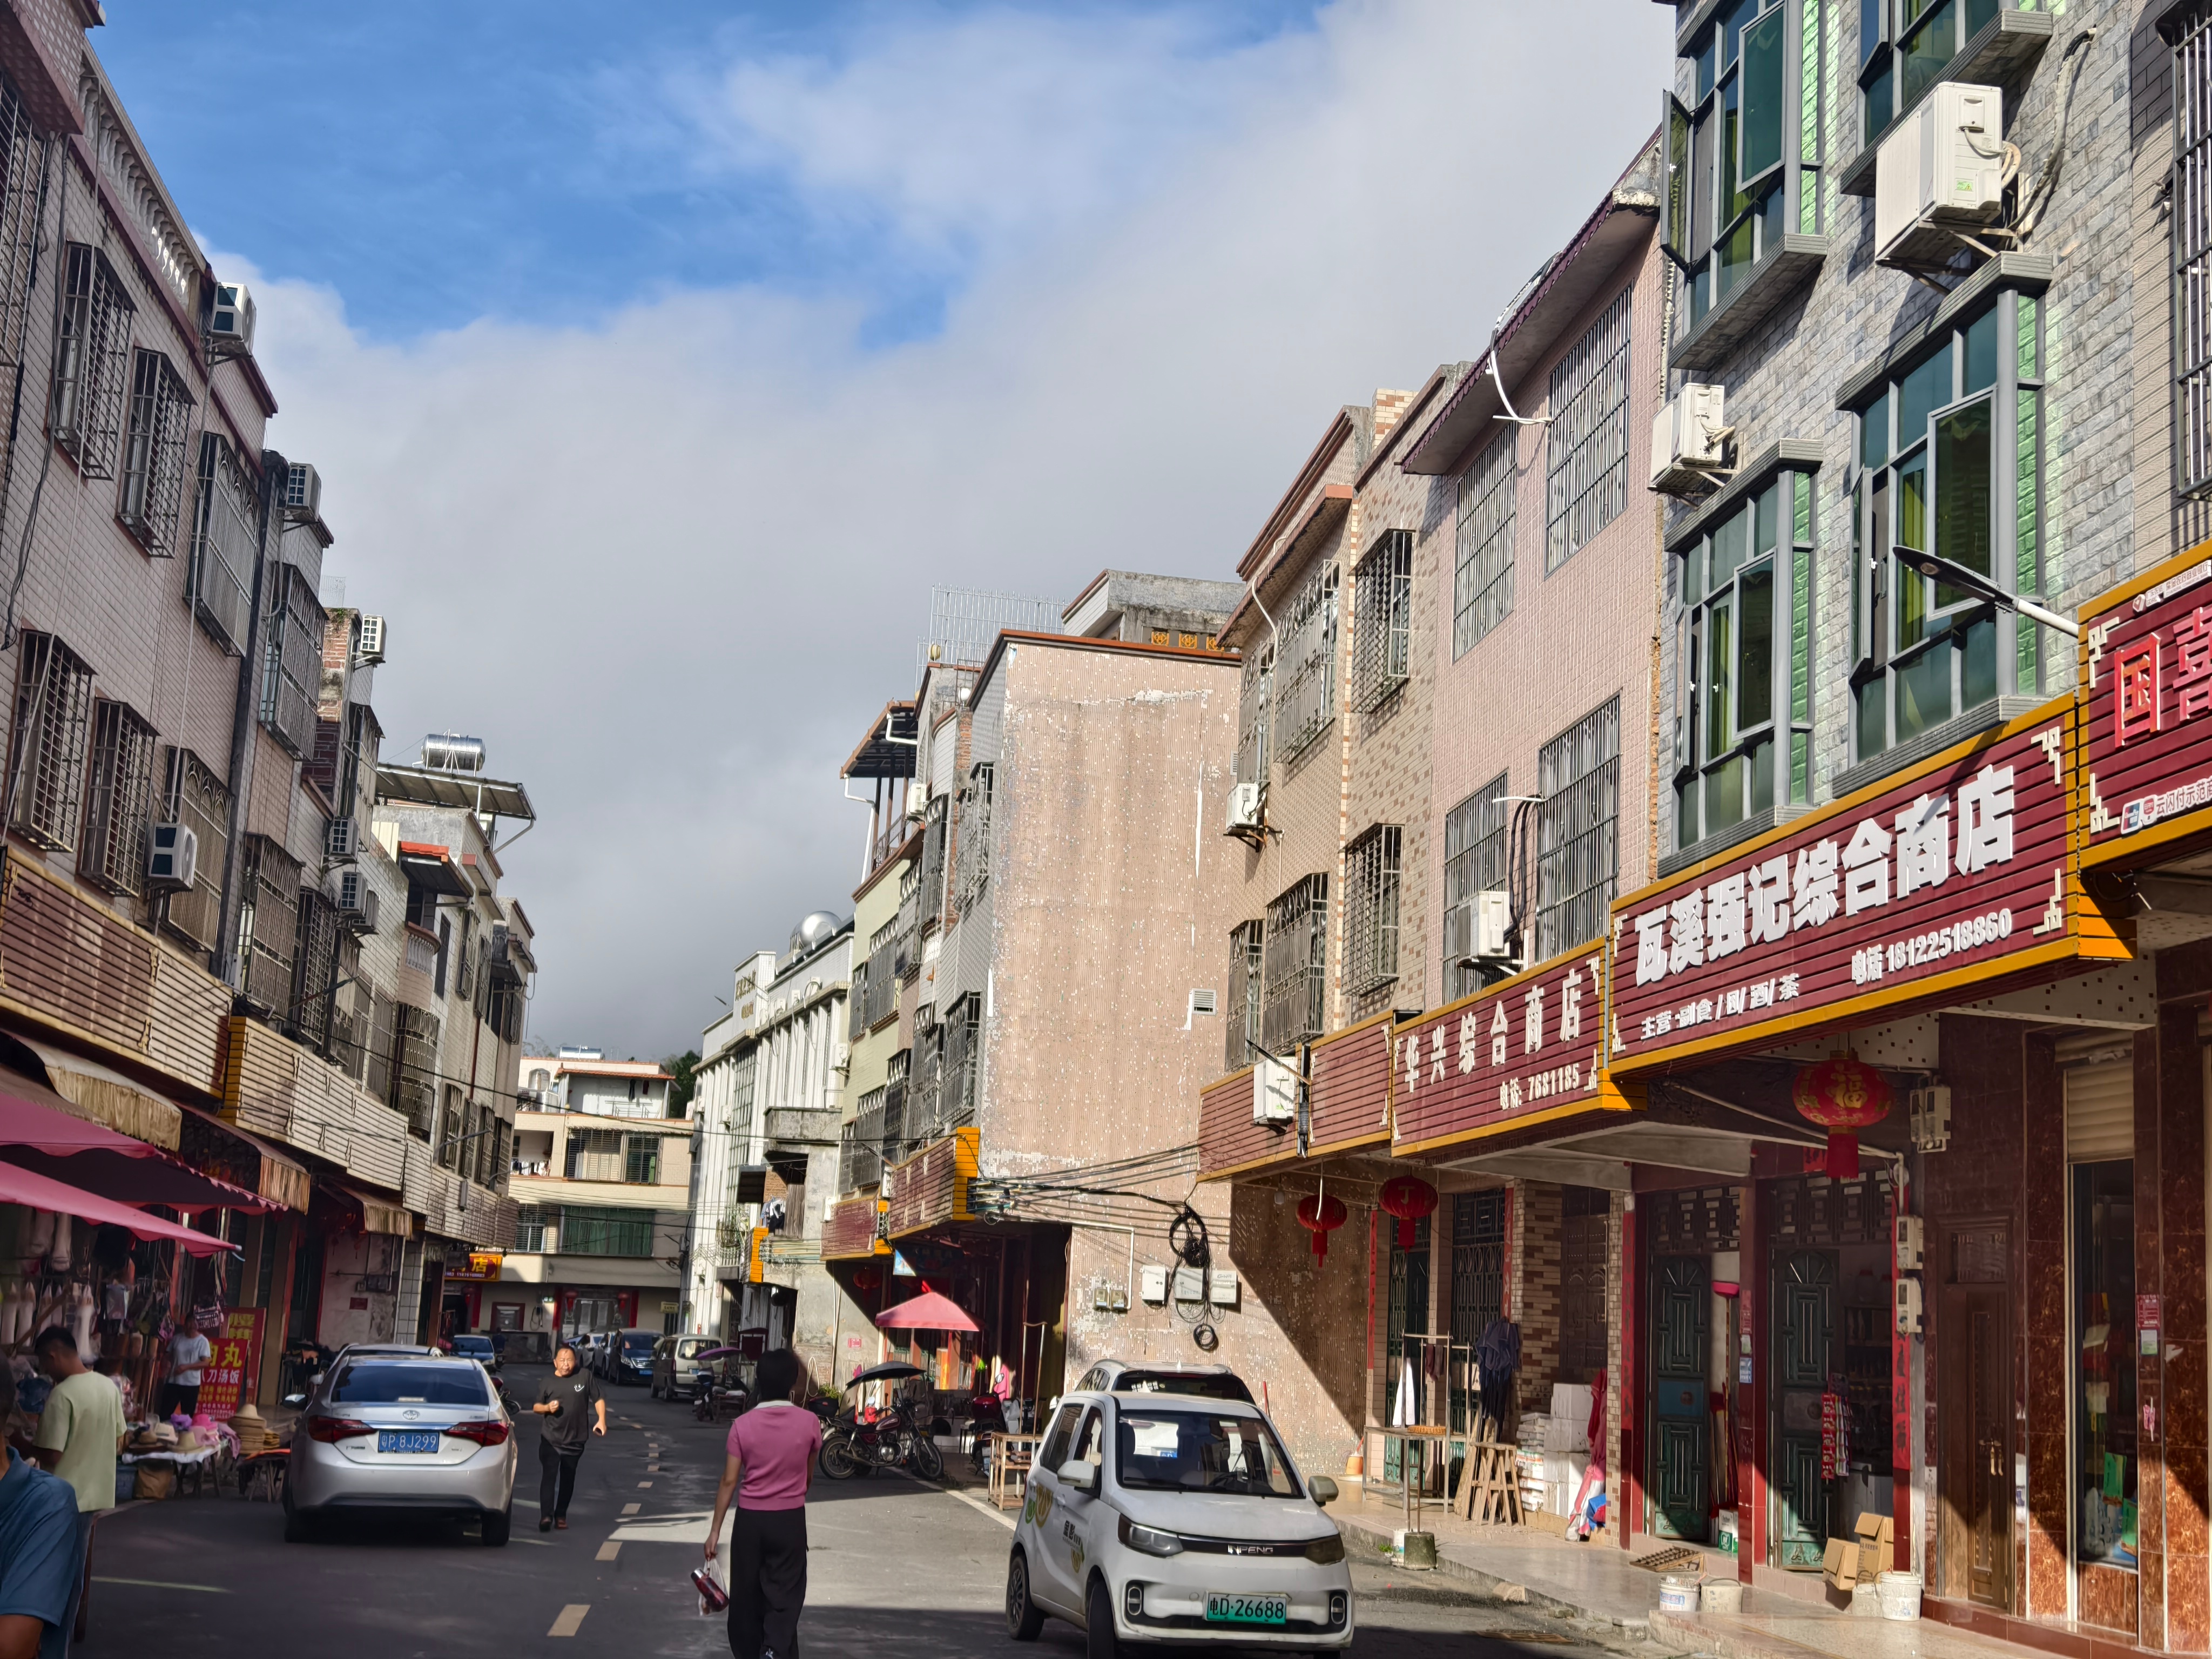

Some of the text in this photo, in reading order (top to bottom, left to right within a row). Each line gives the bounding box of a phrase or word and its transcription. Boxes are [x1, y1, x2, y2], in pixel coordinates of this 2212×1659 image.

[1635, 764, 2015, 987] 瓦溪强记综合商店
[1885, 908, 2013, 972] 18122518860
[1405, 968, 1581, 1093] 华兴综合商店
[1528, 1063, 1579, 1101] 7681185
